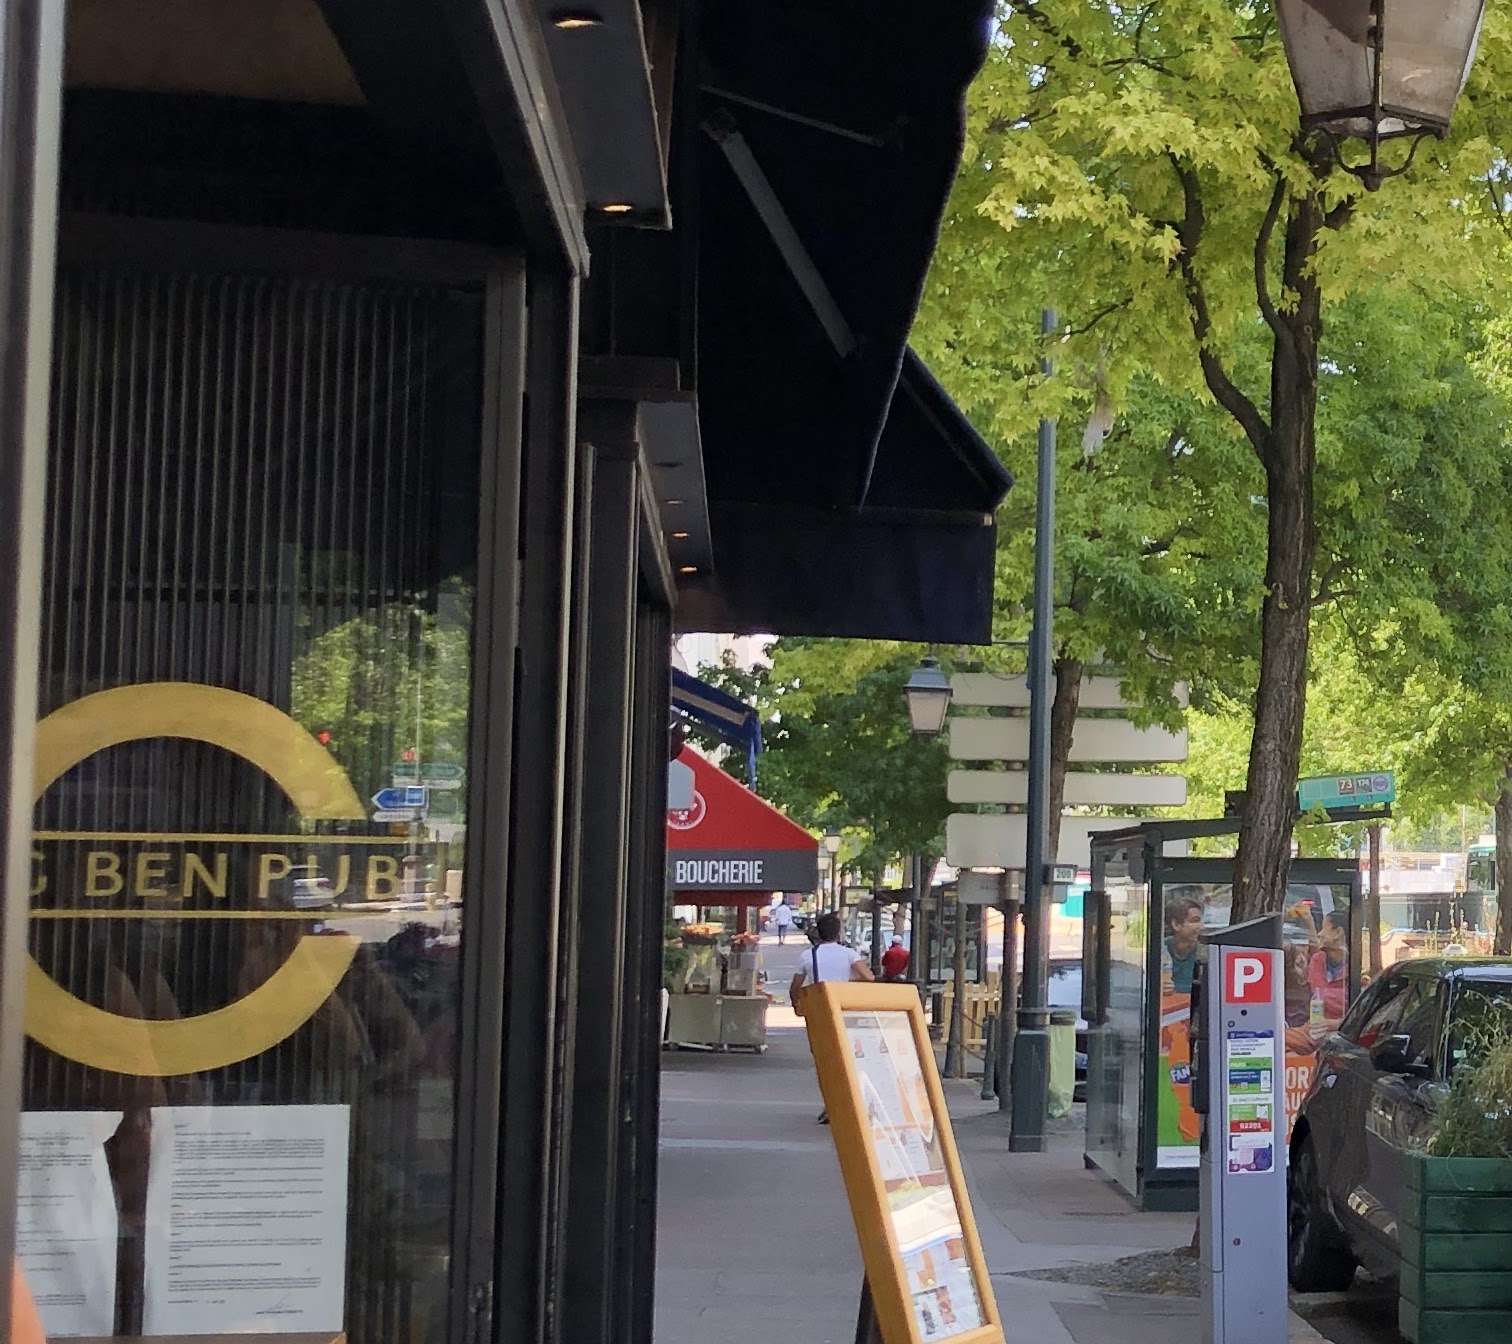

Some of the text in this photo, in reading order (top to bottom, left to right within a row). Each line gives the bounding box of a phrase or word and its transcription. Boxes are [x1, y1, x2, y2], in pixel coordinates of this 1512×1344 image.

[1339, 778, 1353, 790] 73
[85, 851, 228, 898] BEN
[257, 852, 399, 901] PUB
[675, 859, 764, 885] BOUCHERIE
[1233, 957, 1264, 998] P
